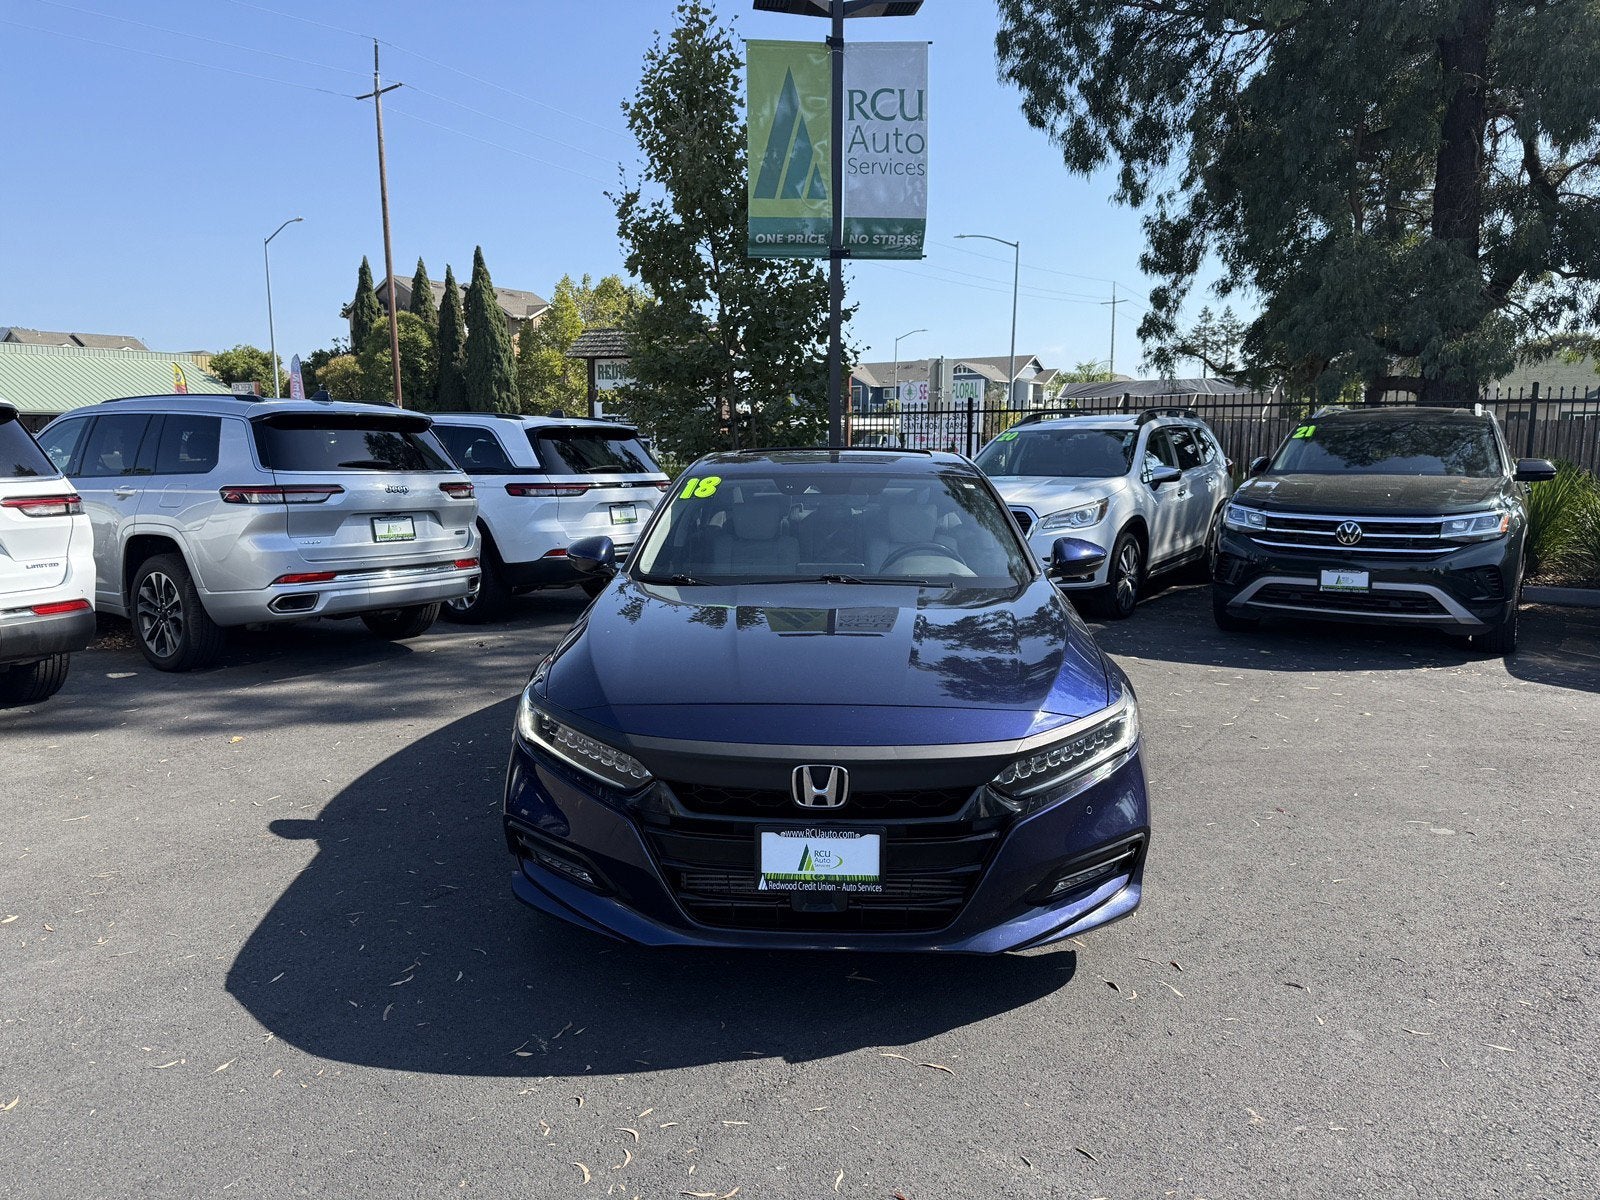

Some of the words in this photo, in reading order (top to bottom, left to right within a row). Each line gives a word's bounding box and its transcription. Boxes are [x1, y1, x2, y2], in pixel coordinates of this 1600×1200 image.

[847, 88, 925, 121] RCU
[847, 125, 925, 154] Auto
[847, 157, 925, 176] Services
[755, 233, 784, 244] ONE
[787, 233, 826, 244] PRICE
[849, 234, 870, 244] NO
[872, 234, 919, 245] STRESS
[996, 431, 1019, 442] 20
[1292, 425, 1317, 438] 21
[385, 485, 410, 495] Jeep
[679, 476, 722, 499] 18
[785, 828, 855, 839] www.RCUauto.com
[814, 850, 831, 858] RCU
[768, 881, 797, 891] Redwood
[798, 881, 817, 891] Credit
[818, 883, 836, 891] Union
[842, 883, 857, 892] Auto
[858, 883, 882, 893] Services
